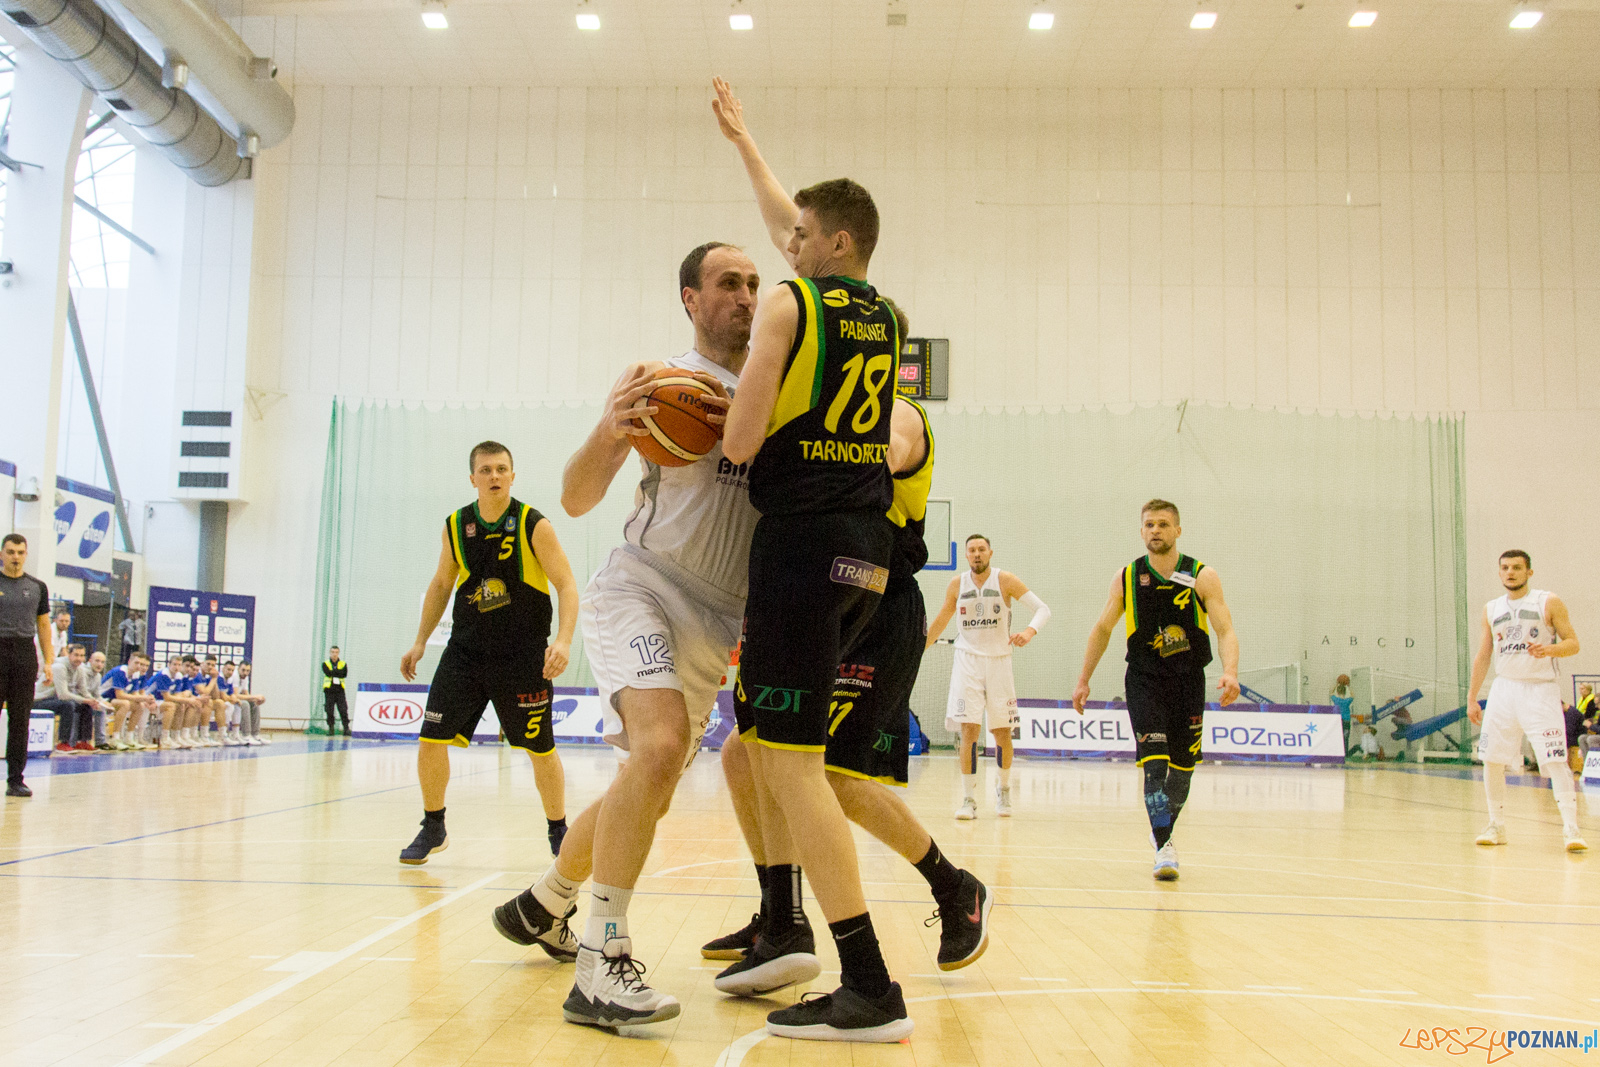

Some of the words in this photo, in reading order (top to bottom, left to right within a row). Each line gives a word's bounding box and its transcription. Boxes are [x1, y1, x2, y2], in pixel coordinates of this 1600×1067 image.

[824, 352, 892, 434] 18
[498, 536, 515, 560] 5
[1173, 587, 1191, 610] 4
[975, 602, 985, 618] 9
[629, 633, 675, 665] 12
[1321, 634, 1331, 645] A
[1349, 636, 1358, 646] B
[1377, 637, 1387, 648] C
[1405, 637, 1415, 648] D
[1302, 675, 1310, 686] 2
[517, 689, 548, 704] TUZ
[753, 684, 811, 713] ZOT
[378, 705, 413, 719] KIA
[525, 716, 542, 739] 5
[1031, 719, 1129, 740] NICKEL
